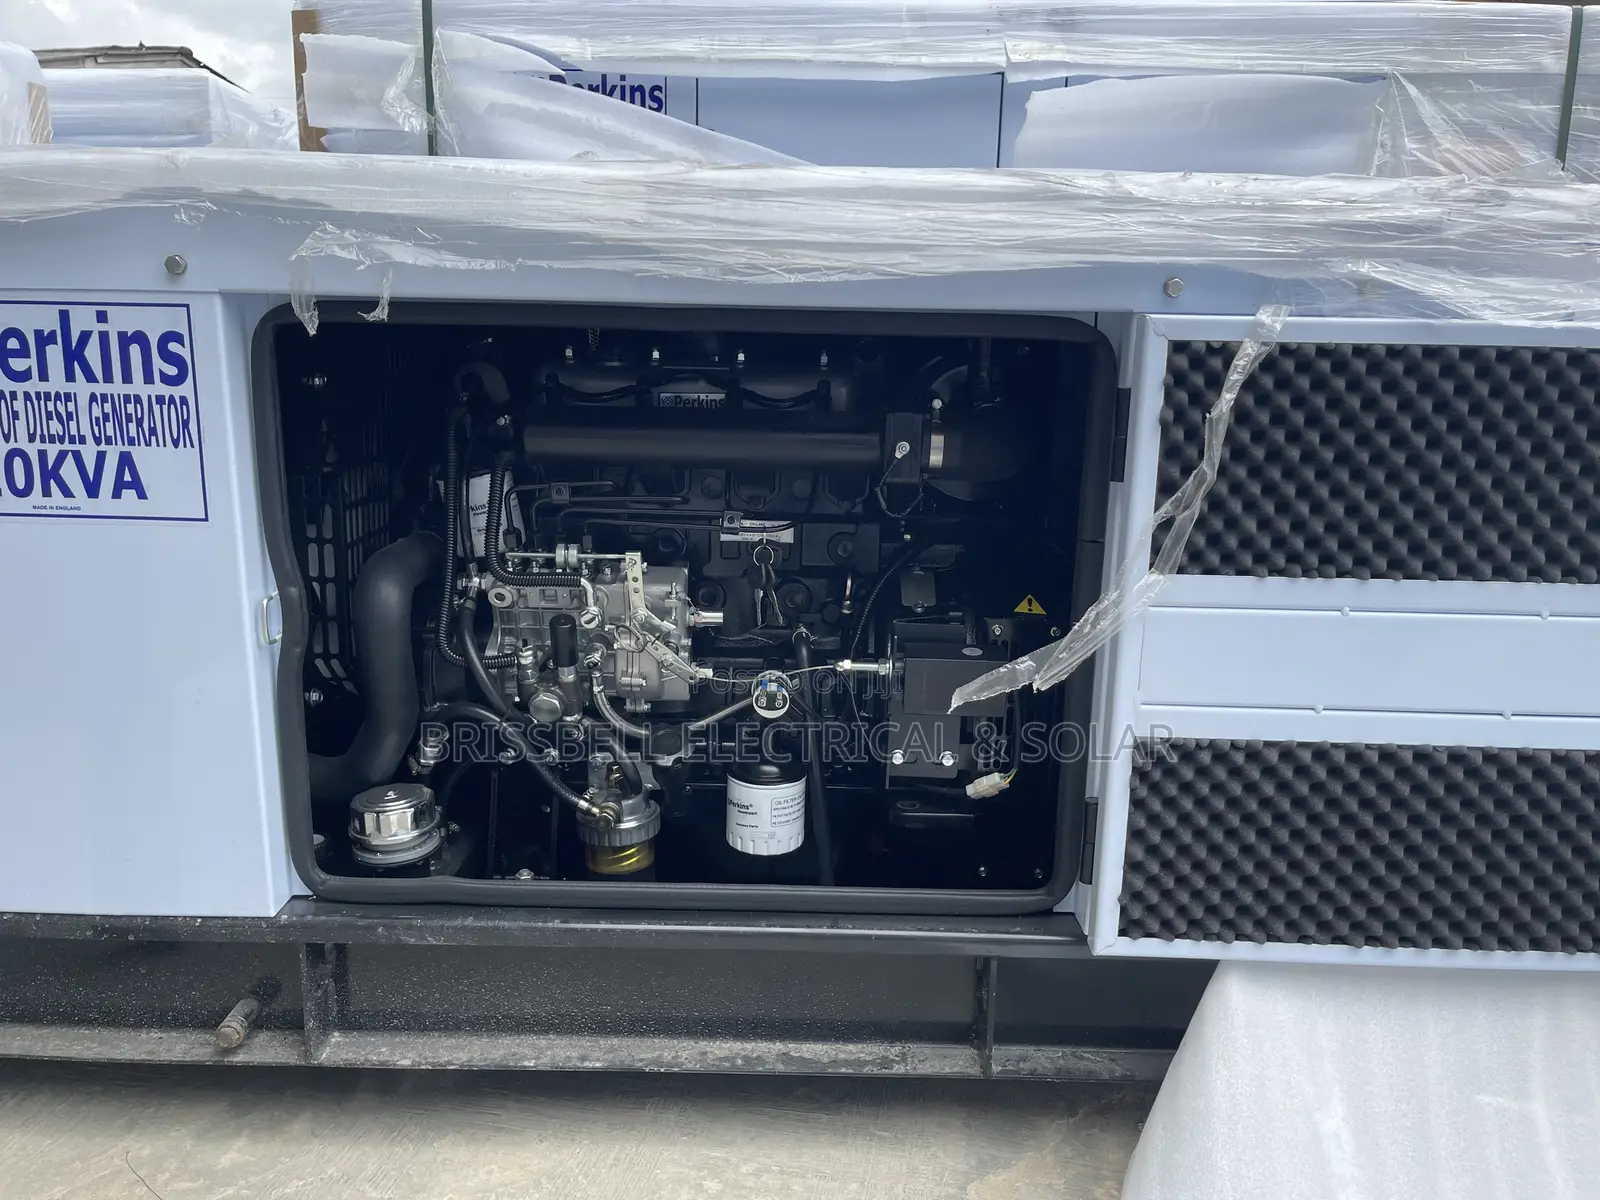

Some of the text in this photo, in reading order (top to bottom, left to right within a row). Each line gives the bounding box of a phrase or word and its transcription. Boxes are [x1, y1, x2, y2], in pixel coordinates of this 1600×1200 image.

[23, 390, 87, 445] DIESEL
[88, 391, 195, 449] GENERATOR
[674, 394, 725, 408] Perkins
[0, 447, 149, 500] 0KVA
